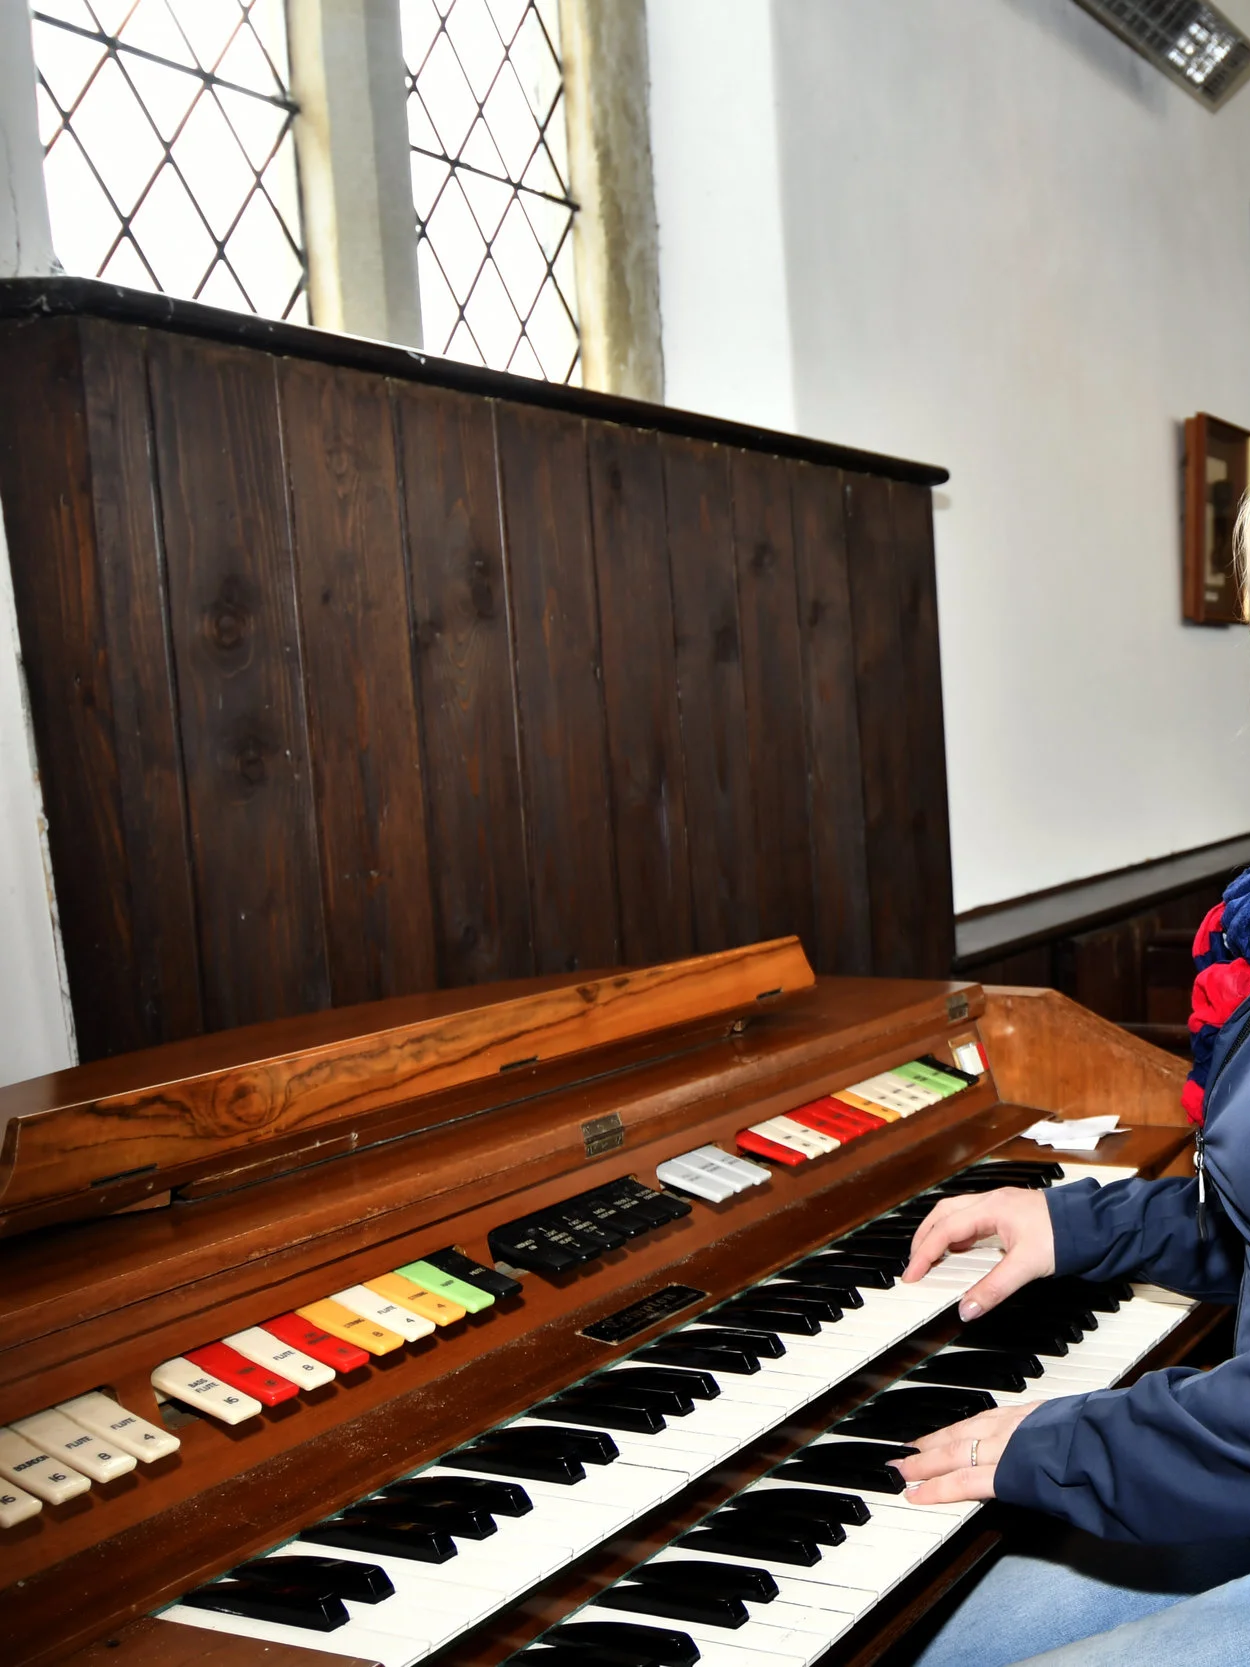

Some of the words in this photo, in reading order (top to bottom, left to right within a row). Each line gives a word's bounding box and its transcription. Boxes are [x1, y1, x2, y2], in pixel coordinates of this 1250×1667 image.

[377, 1305, 398, 1315] FLUTE
[272, 1350, 296, 1361] FLUTE
[188, 1378, 208, 1388] BASS
[195, 1382, 220, 1394] FLUTE
[222, 1396, 240, 1405] 16
[110, 1417, 137, 1431] FLUTE
[143, 1433, 156, 1441] 4
[65, 1435, 94, 1450] FLUTE
[98, 1452, 112, 1461] 8
[13, 1455, 50, 1472] BOURDON
[48, 1473, 67, 1482] 16
[0, 1495, 16, 1505] 16
